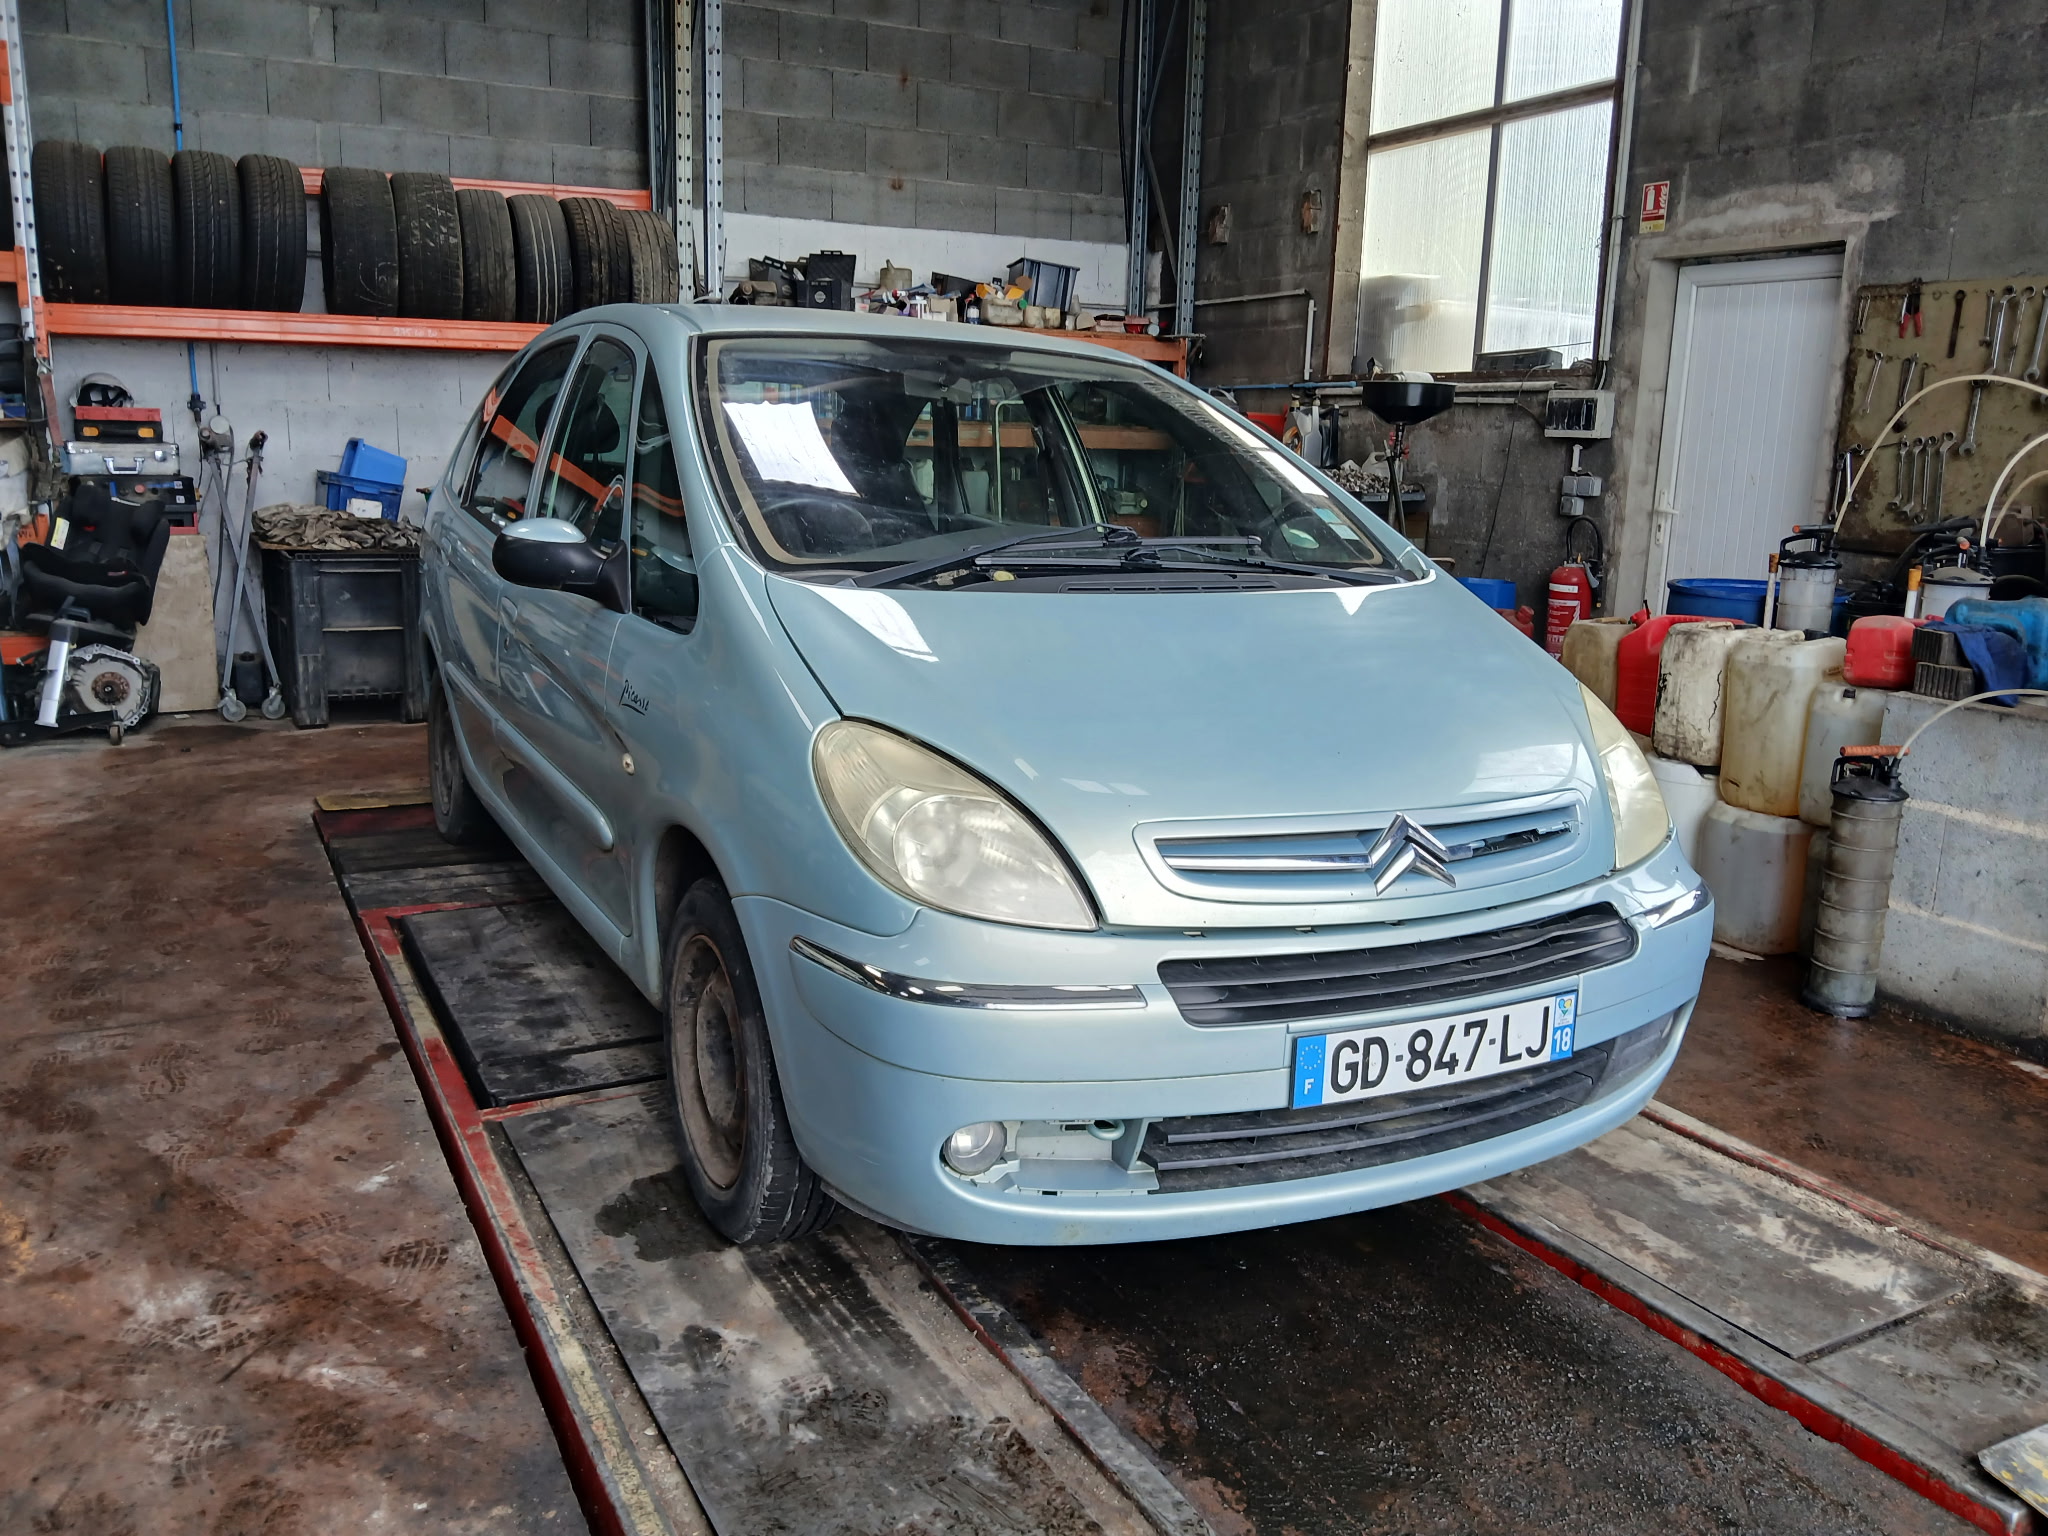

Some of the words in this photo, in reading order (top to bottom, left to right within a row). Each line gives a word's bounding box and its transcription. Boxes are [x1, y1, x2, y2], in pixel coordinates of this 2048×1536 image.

[1330, 1006, 1550, 1094] GD-847-LJ
[1553, 1027, 1572, 1053] 18
[1303, 1078, 1315, 1095] F
